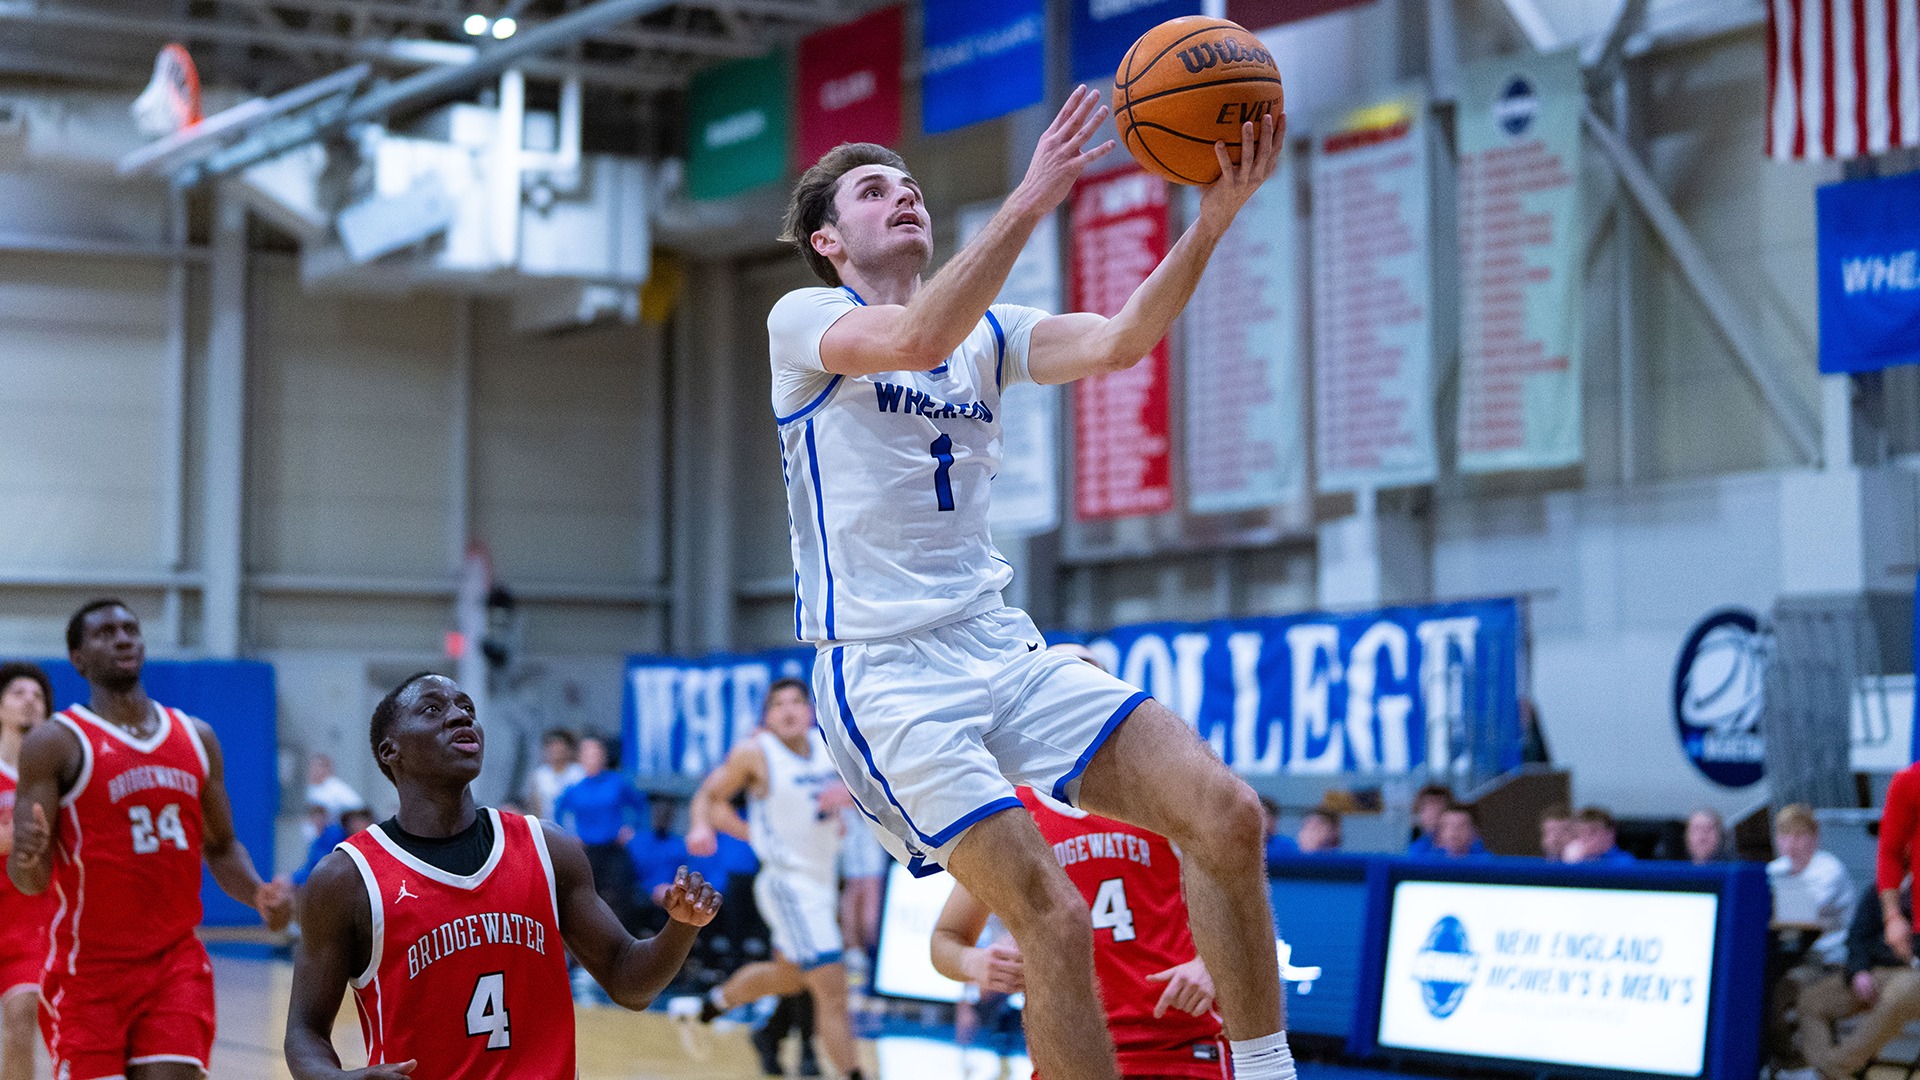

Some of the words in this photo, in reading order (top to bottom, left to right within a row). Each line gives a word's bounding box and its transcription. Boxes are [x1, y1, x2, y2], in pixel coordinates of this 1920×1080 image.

[1176, 37, 1279, 74] Wilson
[1841, 251, 1920, 293] WHE
[930, 432, 955, 512] 1
[1088, 615, 1482, 776] OLLEGE
[108, 765, 199, 804] BRIDGEWATER
[128, 803, 190, 855] 24
[1090, 877, 1136, 942] 4
[407, 912, 546, 980] BRIDGEWATER
[1551, 931, 1663, 965] ENGLAND
[464, 970, 511, 1052] 4
